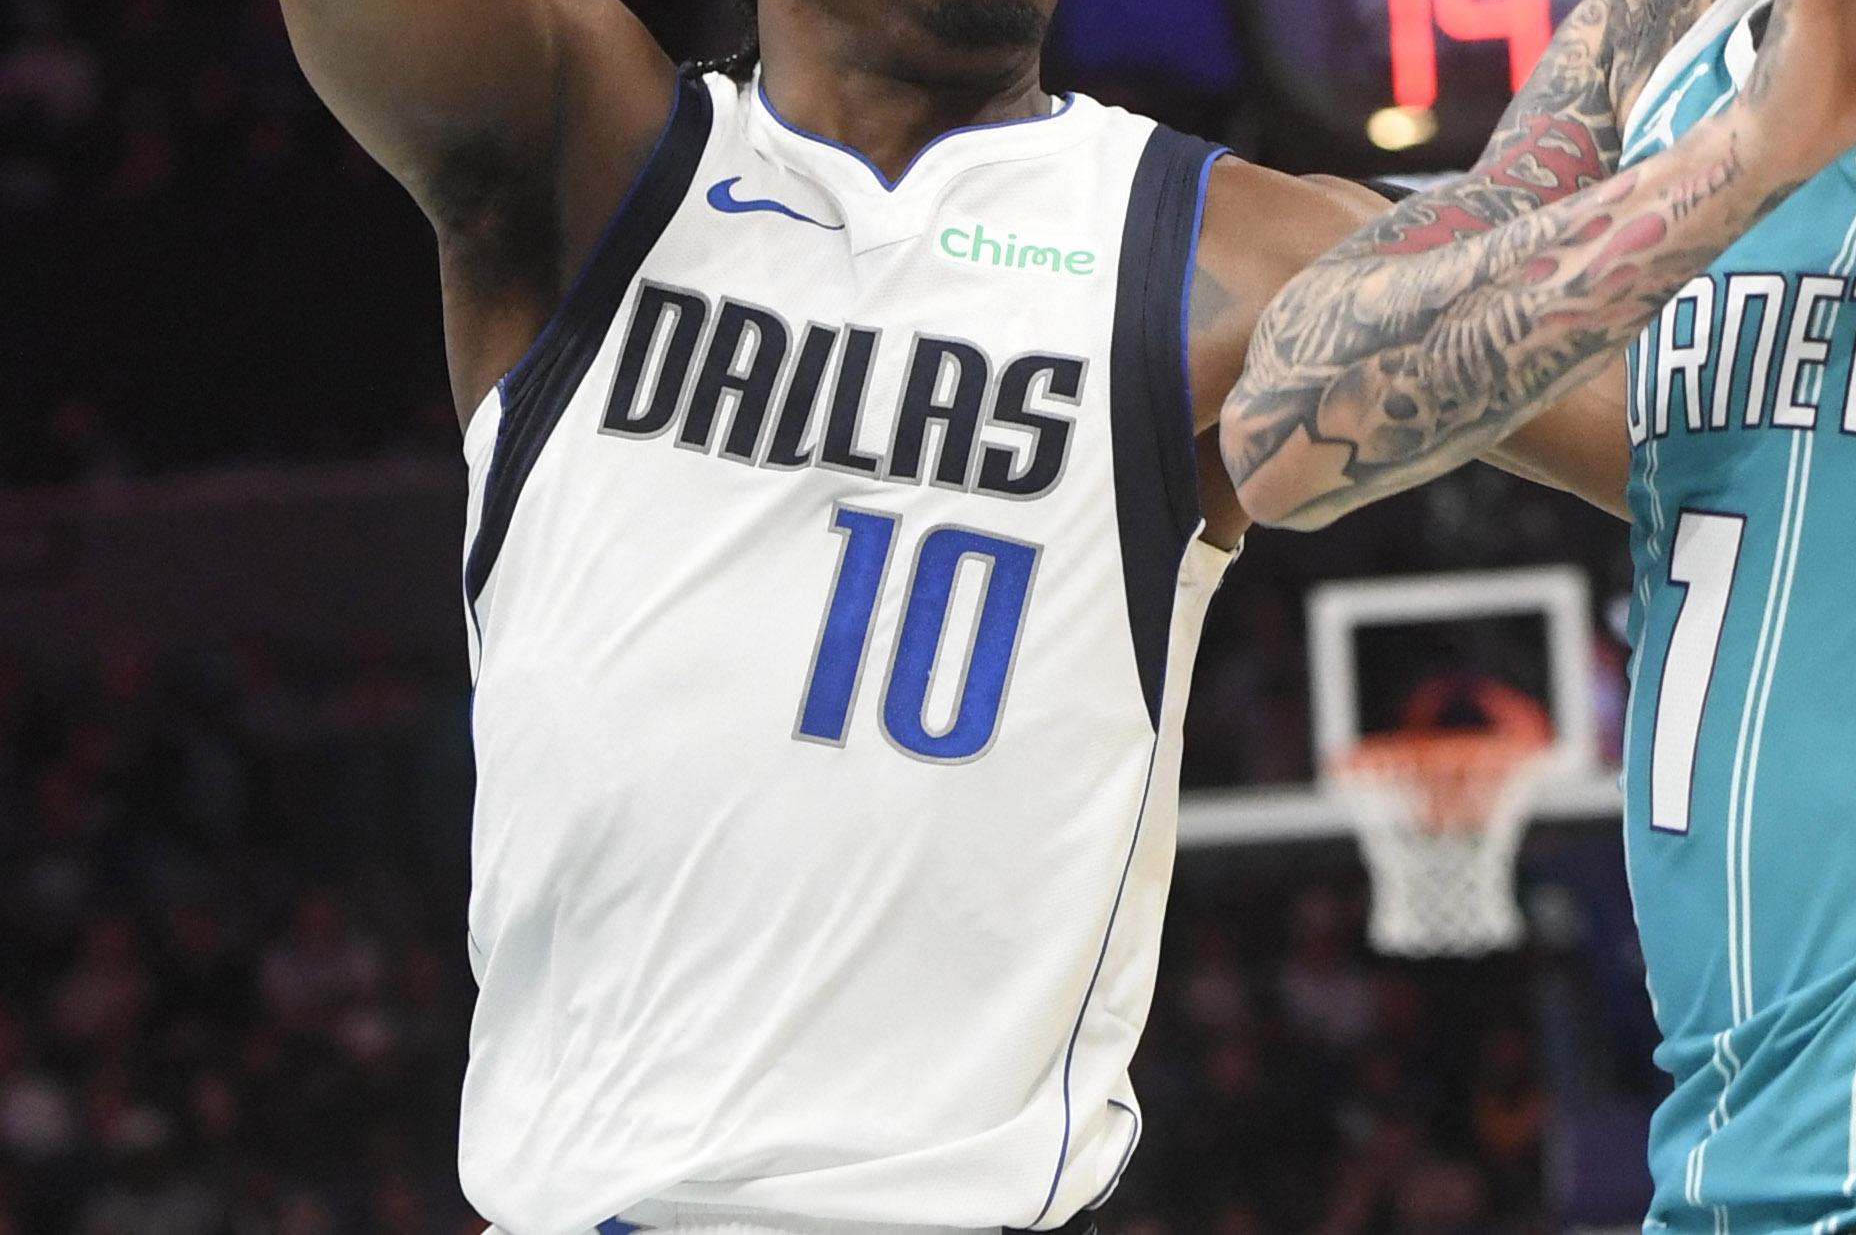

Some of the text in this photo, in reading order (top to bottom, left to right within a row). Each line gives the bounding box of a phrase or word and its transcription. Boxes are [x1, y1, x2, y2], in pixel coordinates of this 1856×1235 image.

[940, 224, 1095, 275] chime
[597, 277, 1089, 503] DALLAS
[791, 500, 1044, 765] 10
[1650, 506, 1748, 836] 1
